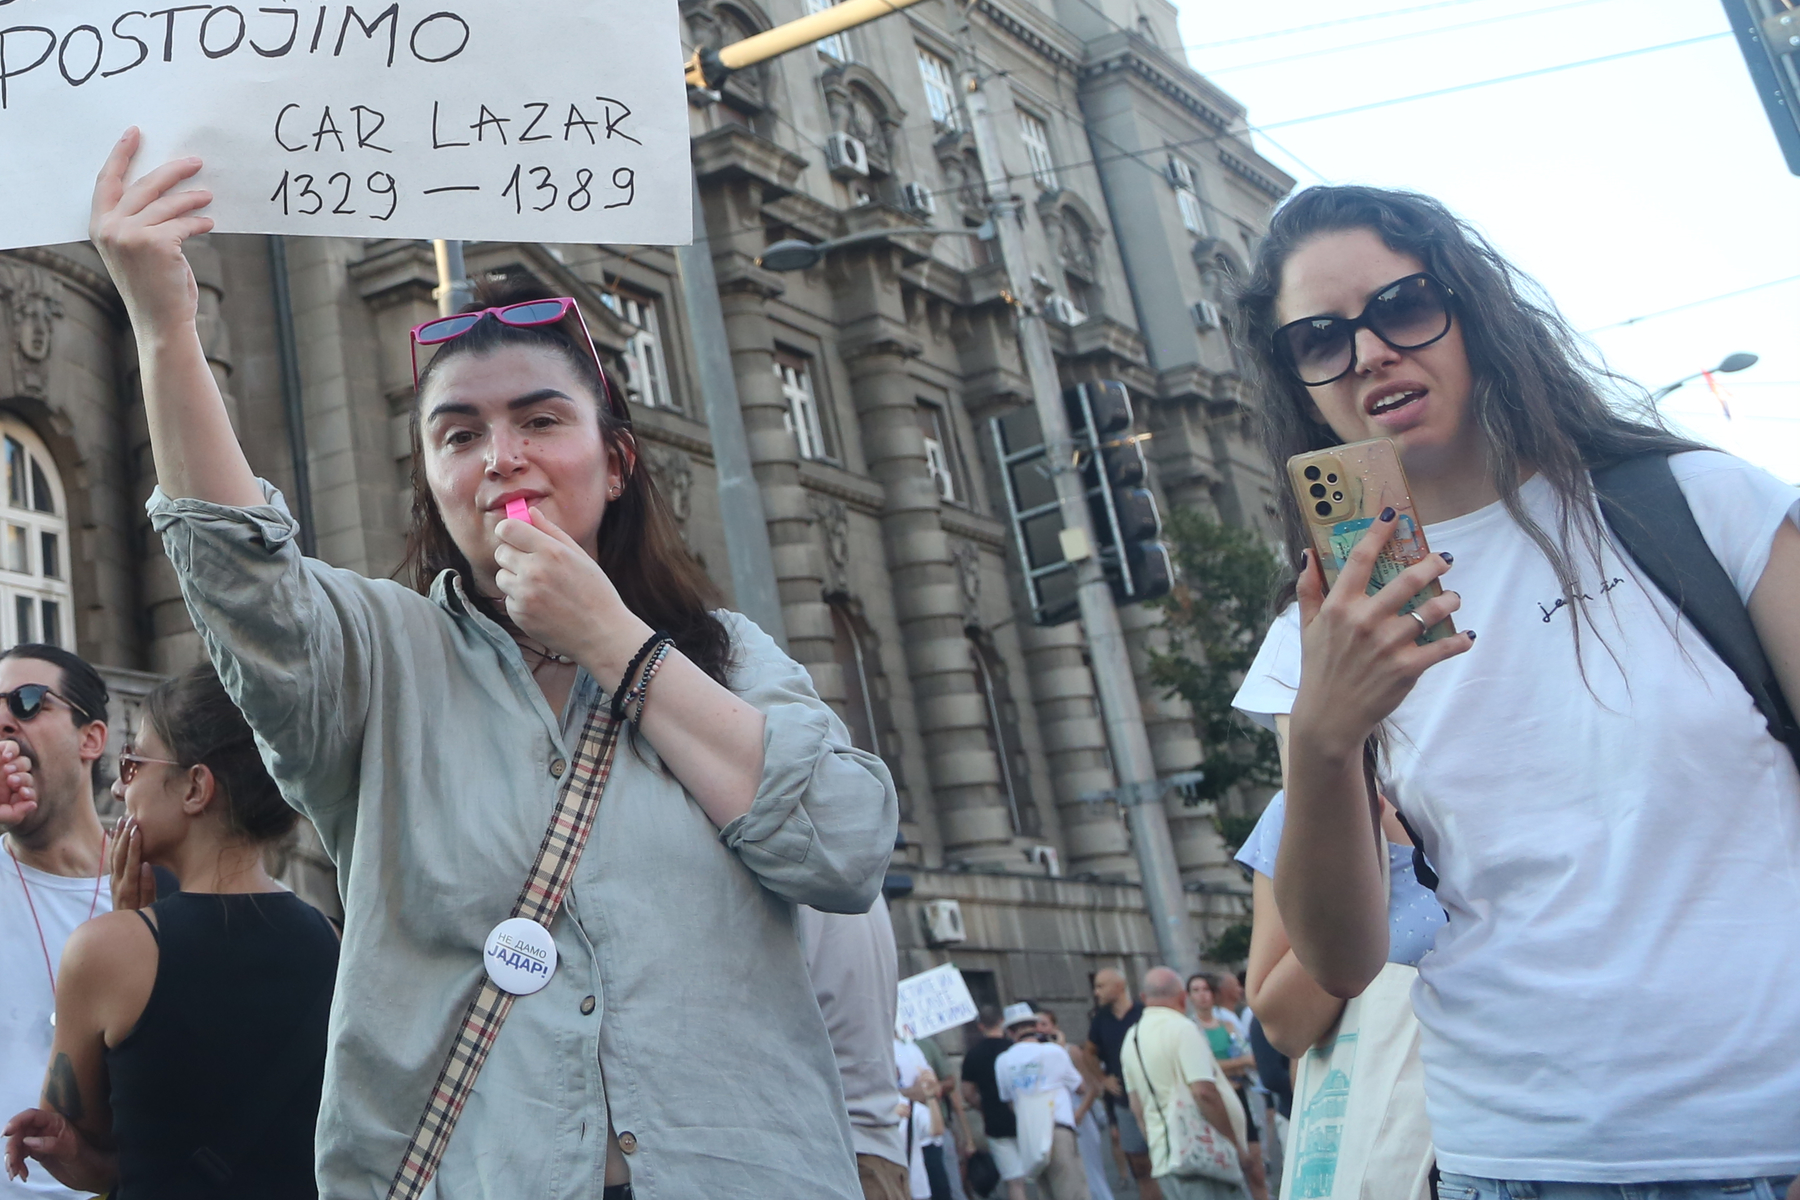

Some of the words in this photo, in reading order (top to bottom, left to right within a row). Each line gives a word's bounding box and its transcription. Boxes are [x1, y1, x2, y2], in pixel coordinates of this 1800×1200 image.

[275, 103, 392, 153] CAR
[433, 97, 642, 149] LAZAR
[271, 169, 397, 221] 1329
[502, 164, 634, 214] 1389
[487, 945, 549, 979] ЈАДАР!
[497, 932, 513, 945] НЕ
[515, 940, 547, 959] ДАМО
